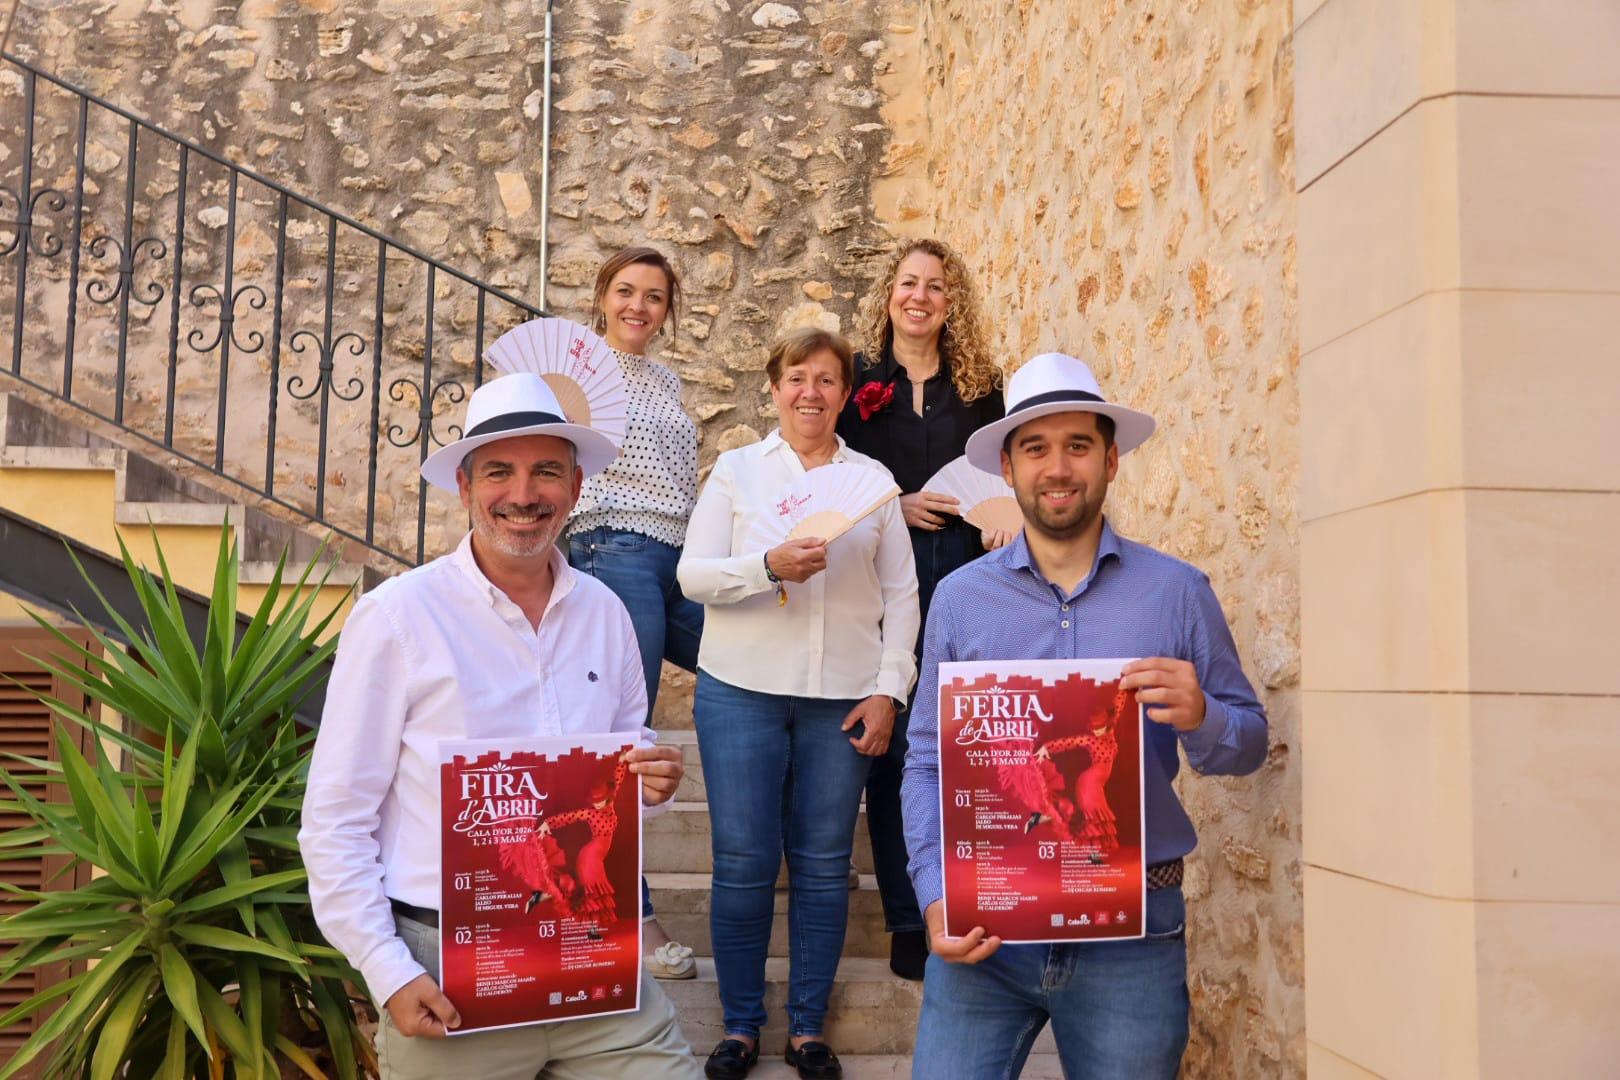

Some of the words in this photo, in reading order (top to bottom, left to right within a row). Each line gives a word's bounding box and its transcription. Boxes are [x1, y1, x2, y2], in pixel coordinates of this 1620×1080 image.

[952, 694, 1053, 722] FERIA
[960, 720, 974, 737] de
[974, 719, 1039, 741] ABRIL
[985, 759, 990, 768] y
[999, 758, 1027, 766] MAYO
[459, 772, 548, 800] FIRA
[955, 794, 972, 808] 01
[454, 798, 544, 828] d'ABRIL
[467, 830, 490, 838] CALA
[492, 828, 513, 837] D'OR
[501, 835, 526, 844] MAIG
[956, 846, 973, 859] 02
[1038, 846, 1055, 859] 03
[455, 876, 472, 890] 01
[455, 930, 472, 945] 02
[539, 924, 555, 938] 03
